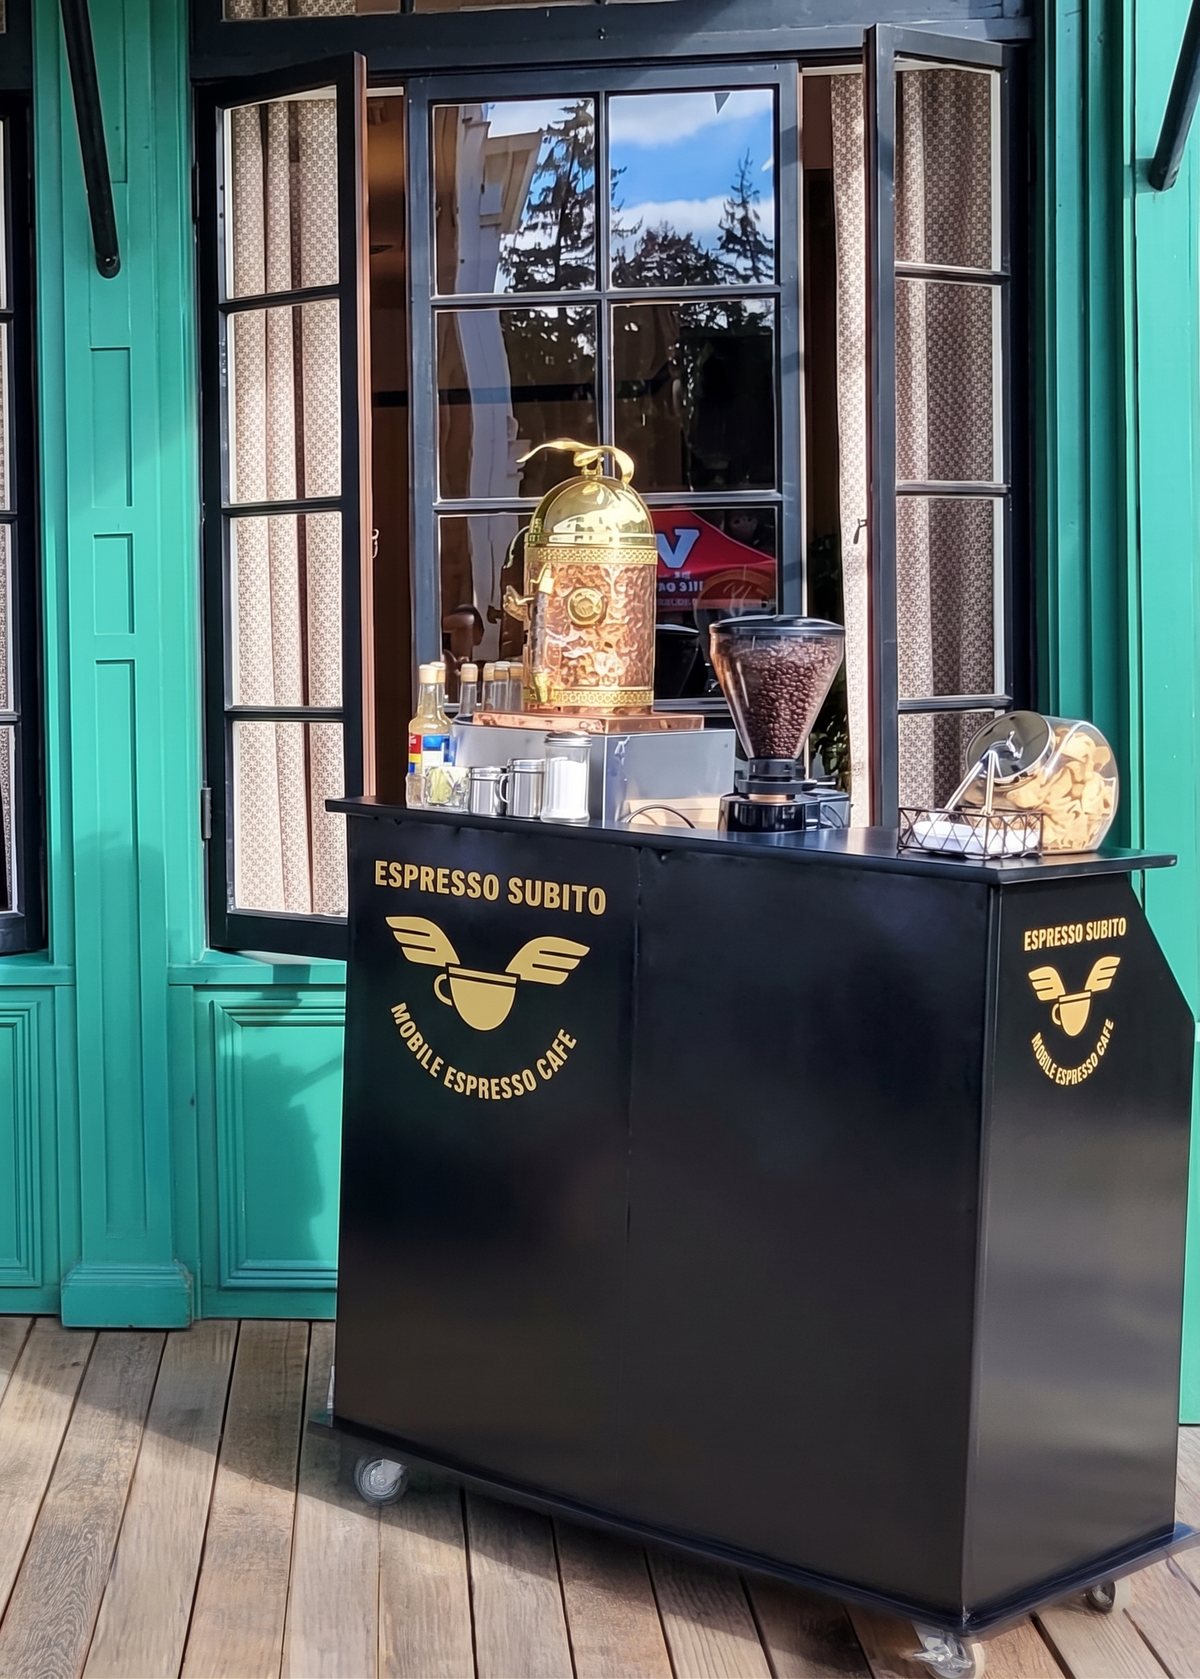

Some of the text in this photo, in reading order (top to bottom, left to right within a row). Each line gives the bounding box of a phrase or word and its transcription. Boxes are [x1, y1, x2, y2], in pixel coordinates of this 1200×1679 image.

[374, 860, 607, 916] ESPRESSO SUBITO
[1024, 917, 1127, 952] ESPRESSO SUBITO
[391, 1002, 577, 1100] MOBILE ESPRESSO CAFE
[1031, 1018, 1115, 1086] MOBILE ESPRESSO CAFE
